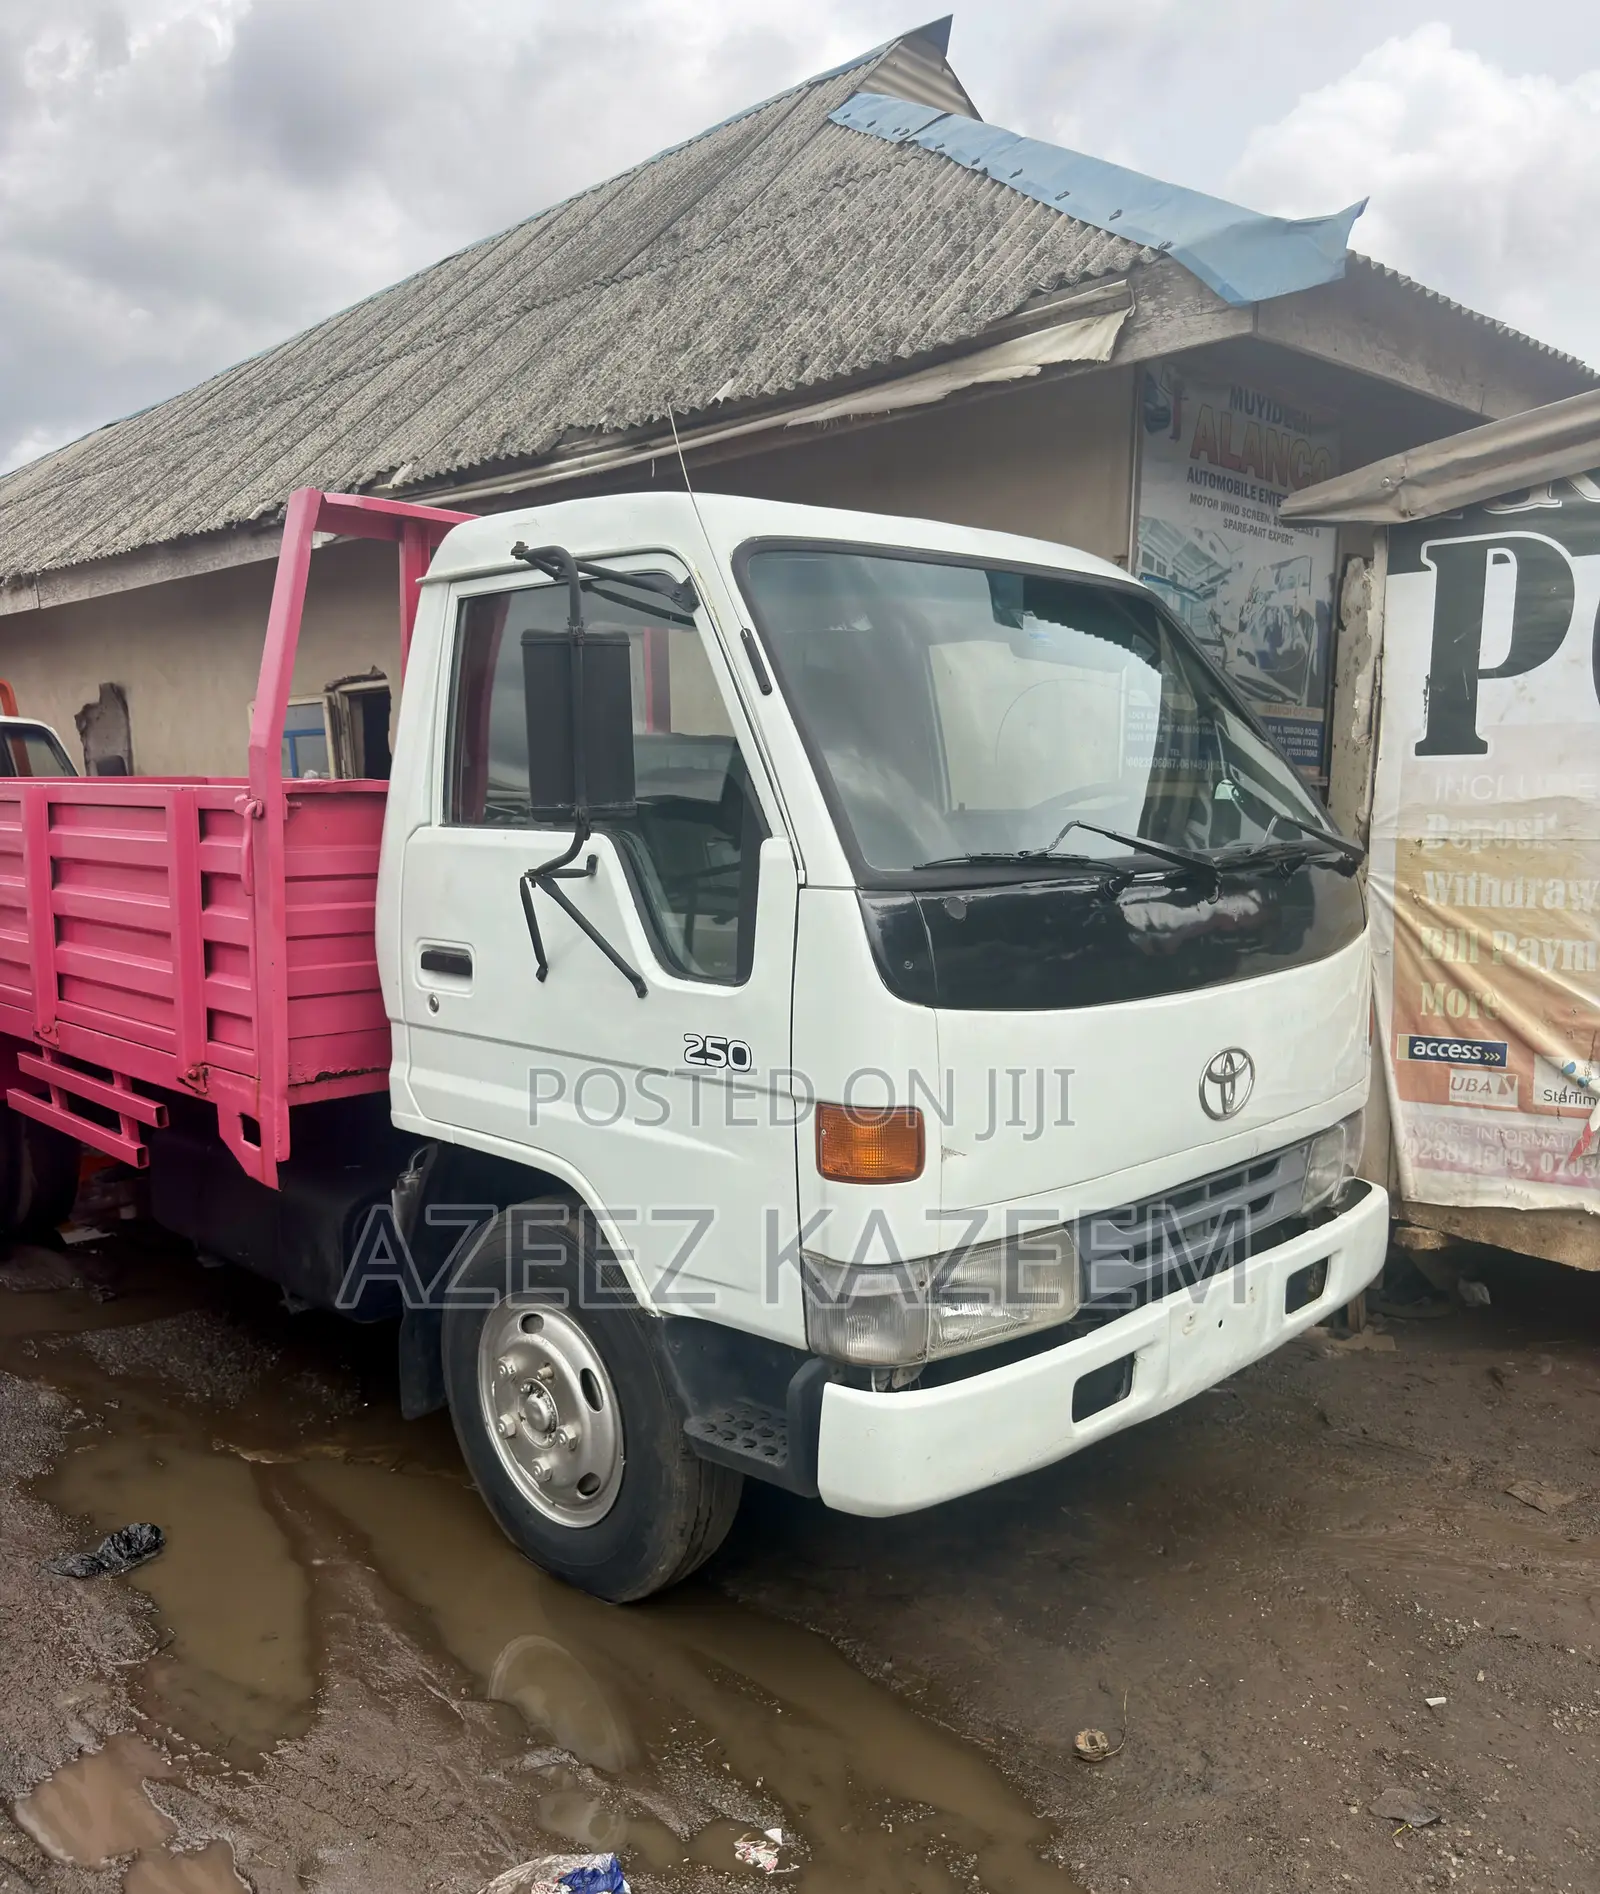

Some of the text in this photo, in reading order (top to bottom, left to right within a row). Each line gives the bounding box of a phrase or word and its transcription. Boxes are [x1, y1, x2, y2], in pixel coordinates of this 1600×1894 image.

[1187, 466, 1257, 500] AUTOMOBILE
[1190, 492, 1219, 511] MOTOR
[1220, 500, 1240, 516] WIND
[1223, 518, 1267, 539] SPARE-PART
[1424, 812, 1559, 854] Deposit
[1420, 926, 1479, 964] Bill
[683, 1033, 752, 1072] 250
[1413, 1040, 1482, 1060] access
[1450, 1076, 1492, 1095] UBA
[1543, 1088, 1599, 1107] StarTim
[1476, 1126, 1576, 1149] INFORMATI
